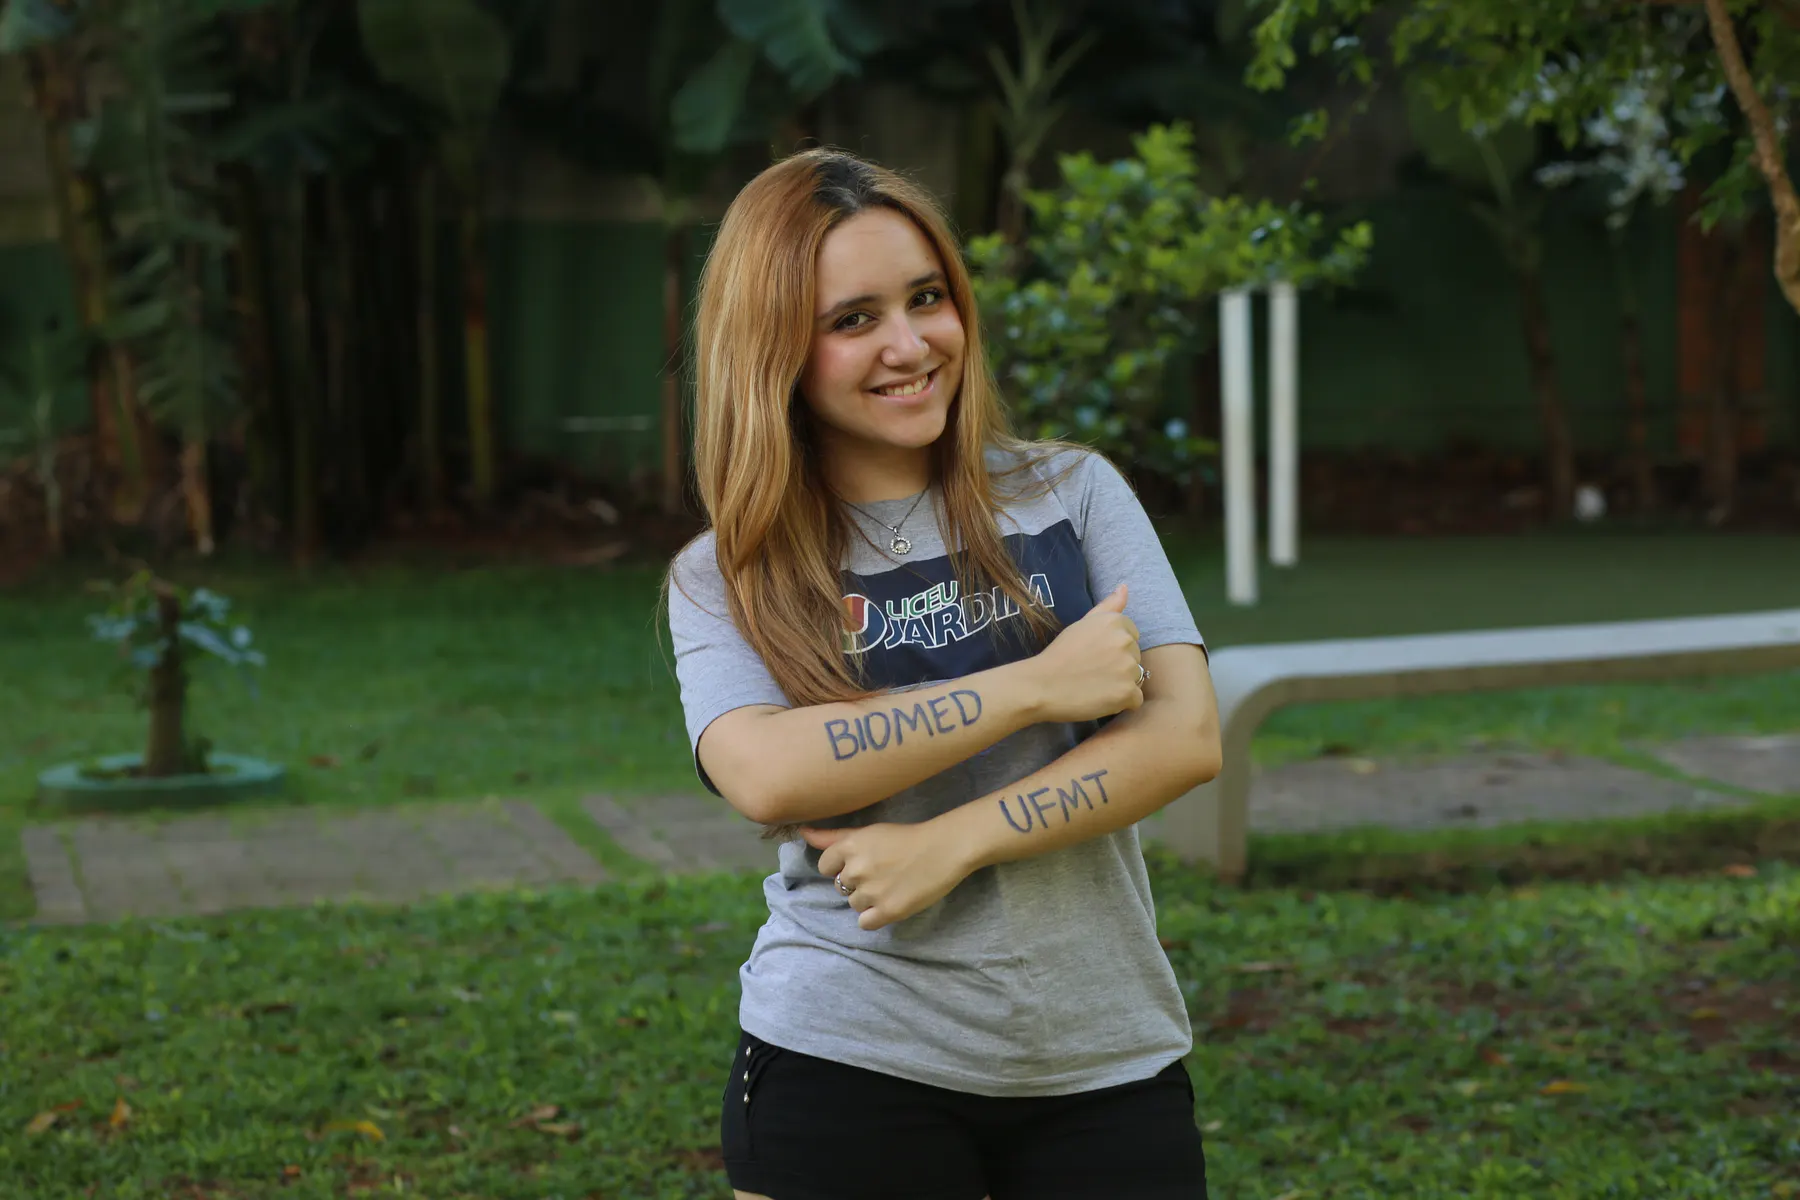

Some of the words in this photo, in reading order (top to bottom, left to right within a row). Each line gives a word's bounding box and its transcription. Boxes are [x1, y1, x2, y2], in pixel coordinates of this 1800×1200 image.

[886, 580, 958, 620] LICEU
[824, 689, 983, 762] BIOMED
[999, 769, 1108, 833] UFMT
